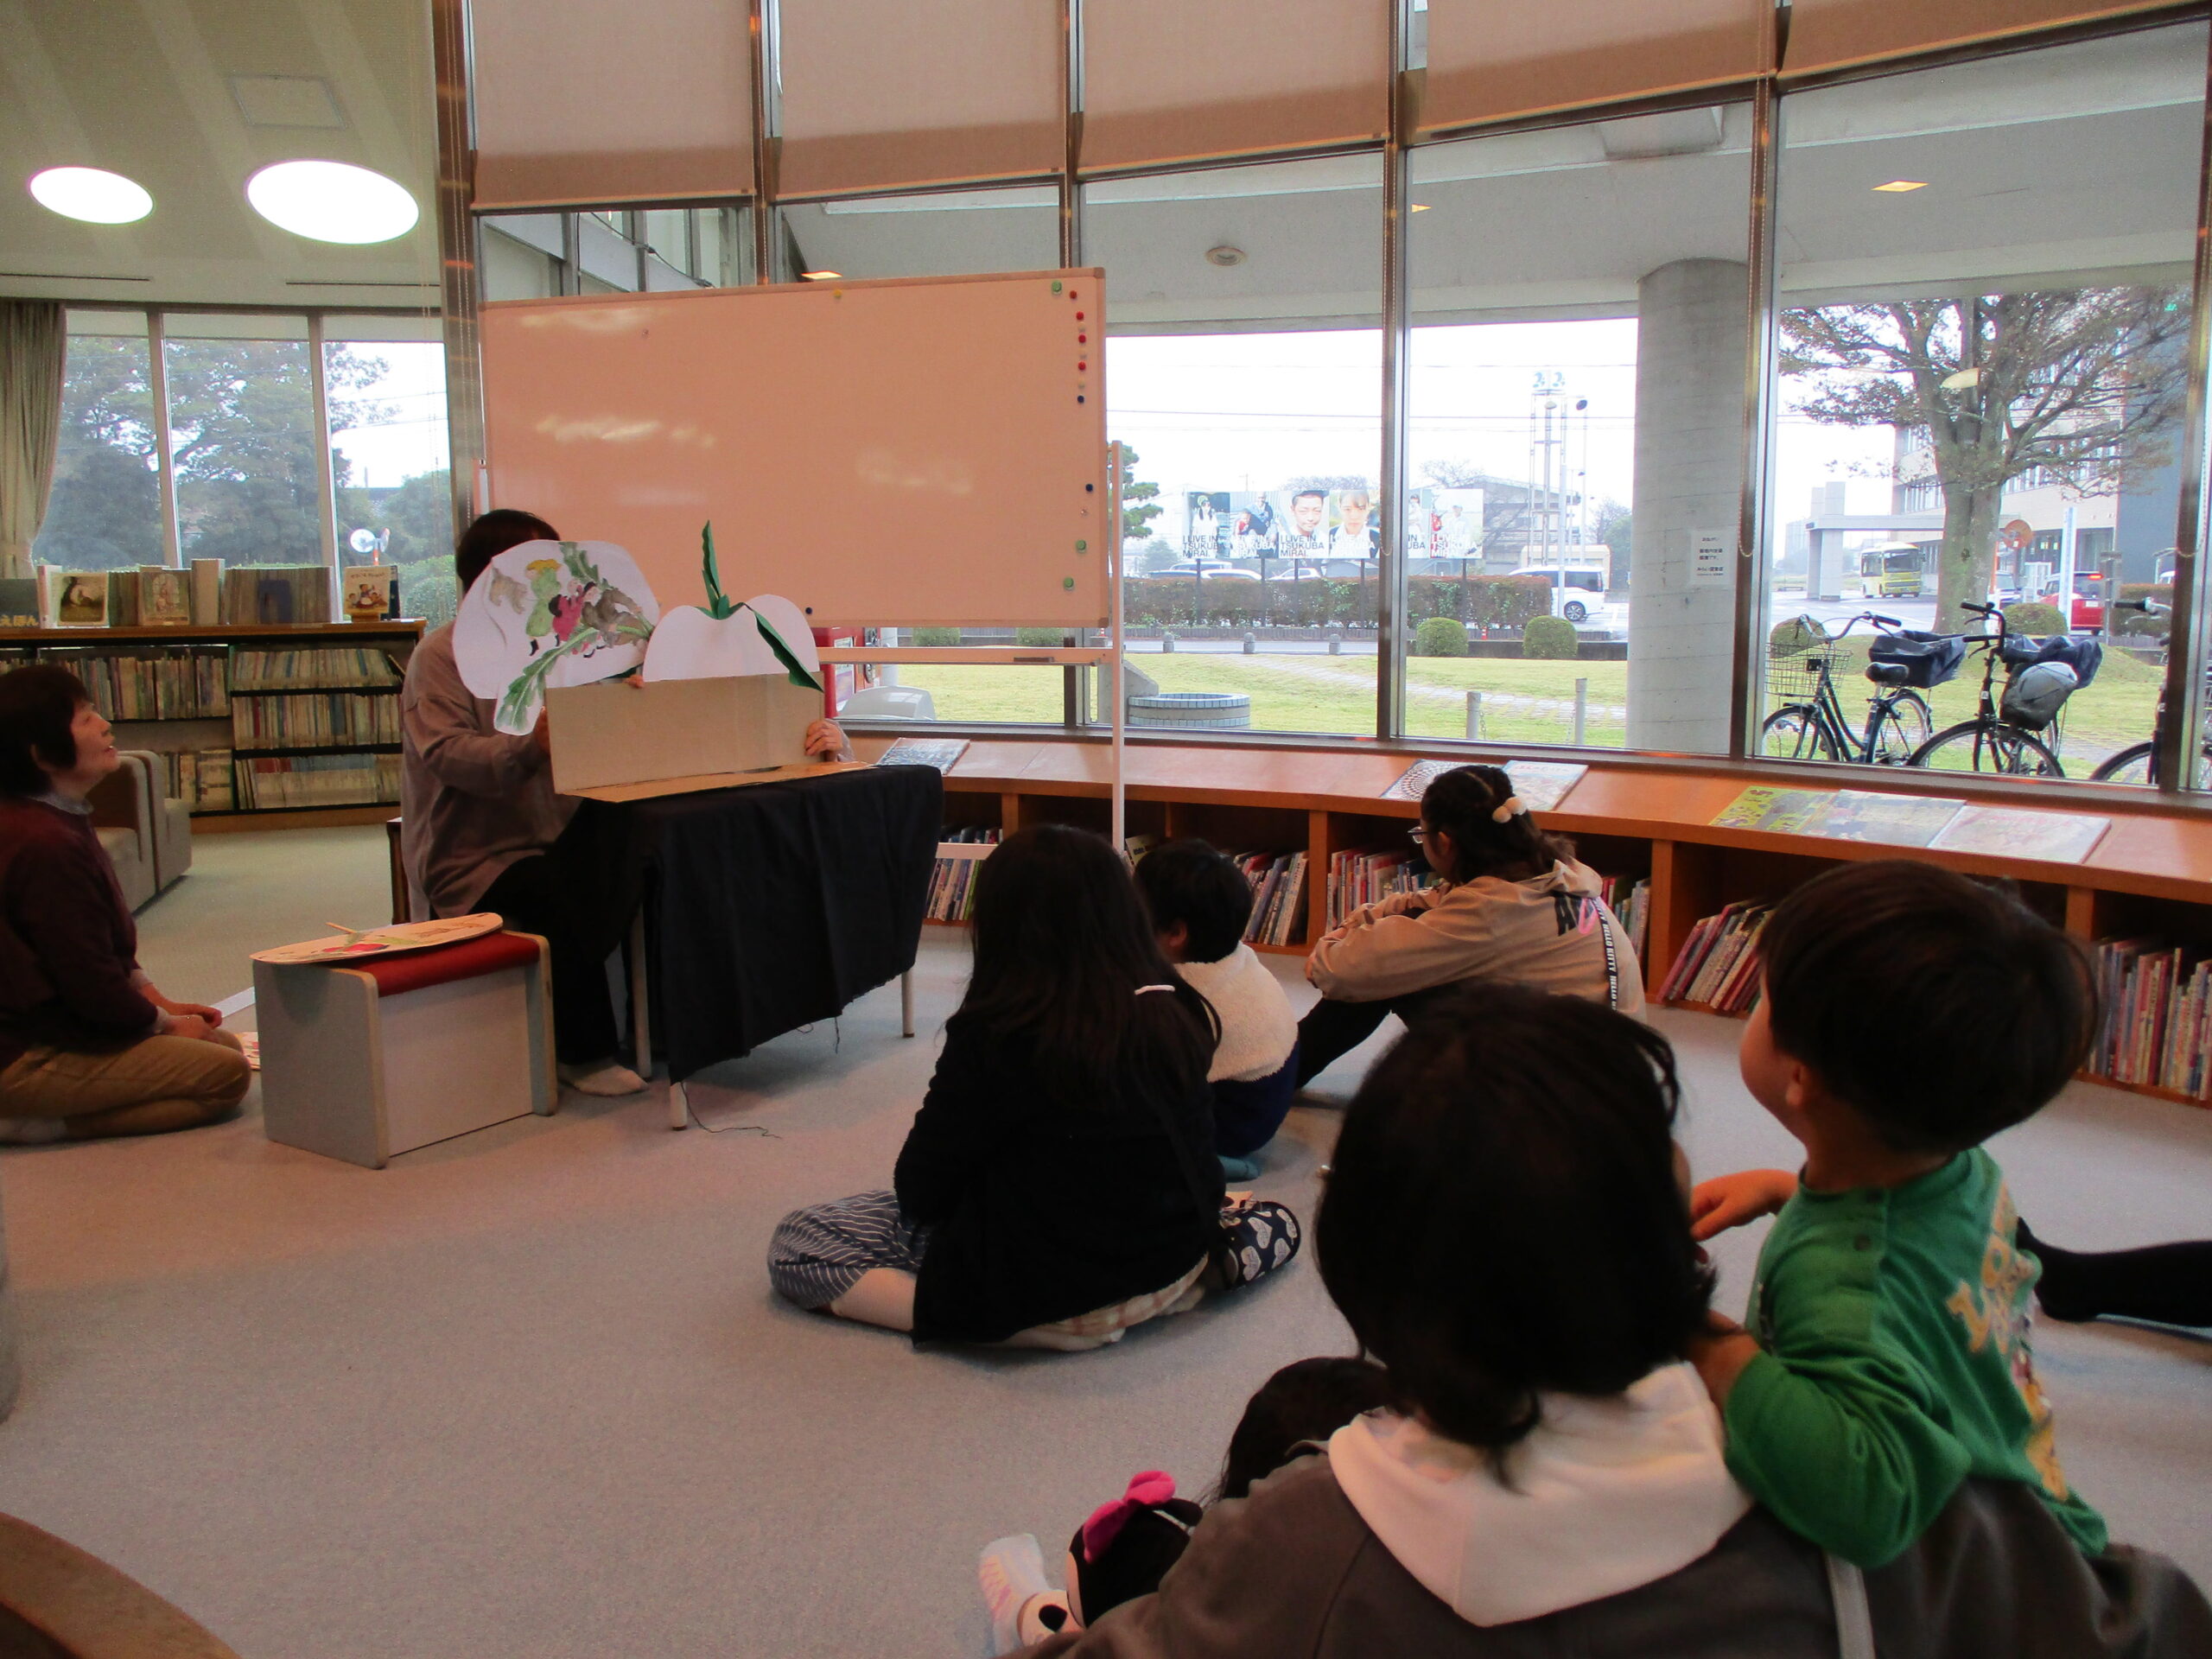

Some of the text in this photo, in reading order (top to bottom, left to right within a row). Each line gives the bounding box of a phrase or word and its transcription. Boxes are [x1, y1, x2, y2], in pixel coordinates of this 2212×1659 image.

[1280, 542, 1325, 550] TSUKUBA
[1603, 924, 1617, 973] HELLO KITTY
